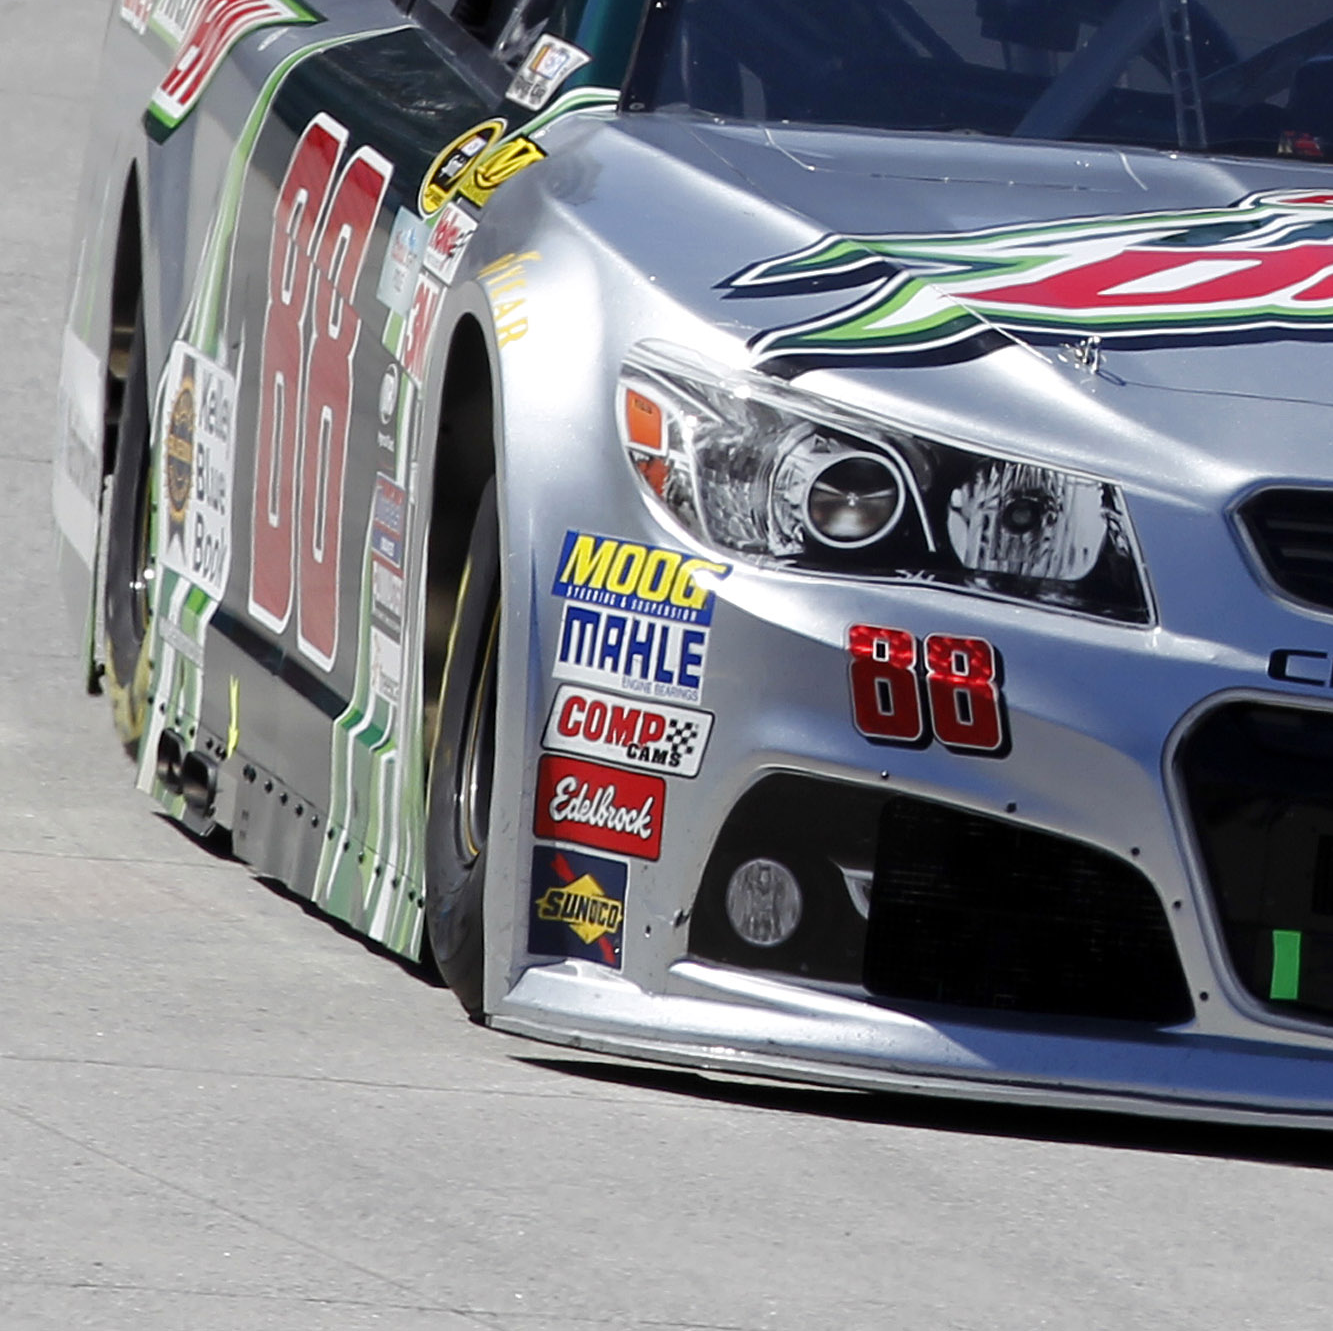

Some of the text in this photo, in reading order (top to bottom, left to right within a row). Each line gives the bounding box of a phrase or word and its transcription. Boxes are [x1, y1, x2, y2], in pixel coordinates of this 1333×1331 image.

[248, 111, 394, 673] 88
[197, 443, 225, 516] Blue
[193, 511, 228, 589] Book
[560, 535, 728, 610] MOOG
[567, 585, 698, 623] STEERING & SUSPENSION
[559, 606, 706, 689] MAHLE
[557, 696, 666, 747] COMP
[621, 676, 699, 703] ENGINE BEARINGS
[847, 622, 1009, 753] 88
[627, 743, 682, 767] CAMS
[550, 776, 654, 840] Edelbrock
[540, 891, 622, 929] SUNOCO
